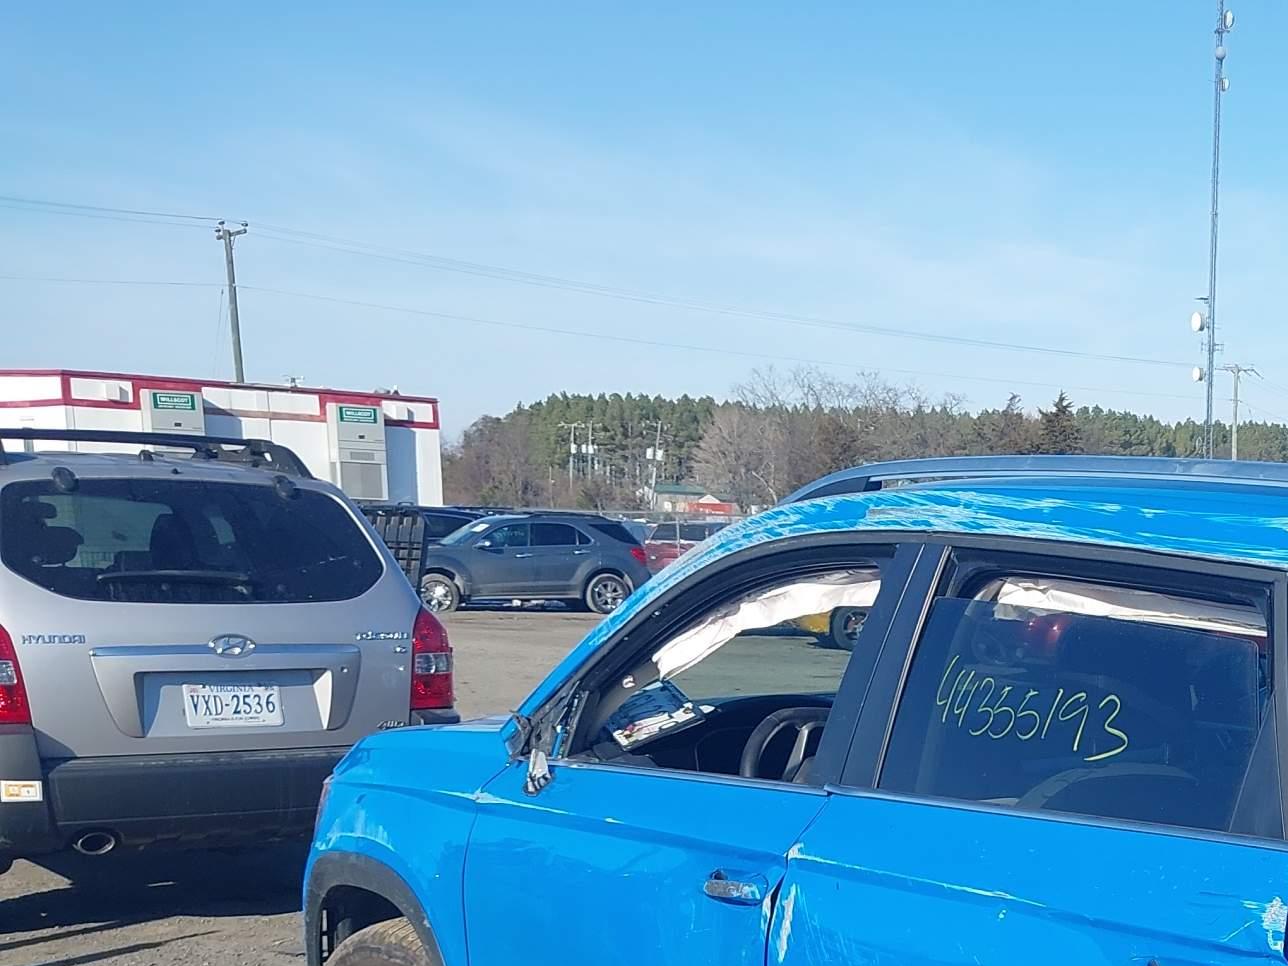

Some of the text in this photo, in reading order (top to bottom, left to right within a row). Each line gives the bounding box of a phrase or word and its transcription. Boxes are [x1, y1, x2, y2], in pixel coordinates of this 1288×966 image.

[21, 634, 86, 645] HYUNDAI
[189, 693, 277, 716] VXD-2536
[935, 655, 1129, 762] 44355193
